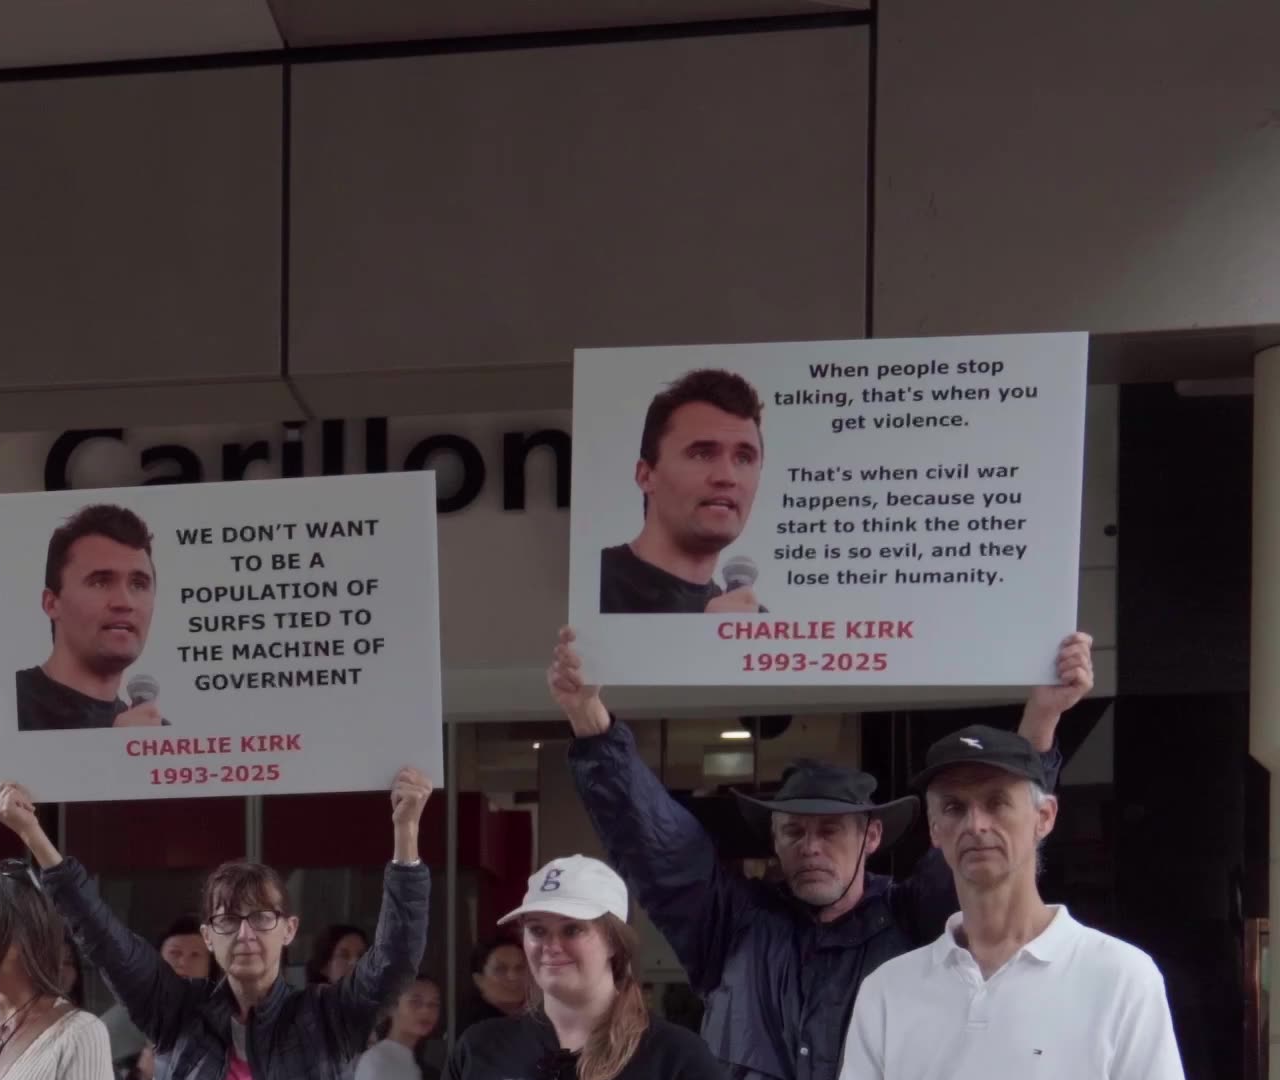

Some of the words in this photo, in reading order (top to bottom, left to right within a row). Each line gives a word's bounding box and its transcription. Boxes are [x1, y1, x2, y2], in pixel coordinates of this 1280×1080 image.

[809, 363, 868, 378] When
[878, 360, 949, 380] people
[957, 360, 1003, 376] stop
[775, 390, 853, 407] talking,
[862, 387, 923, 402] that's
[932, 386, 989, 400] when
[999, 387, 1037, 402] you
[832, 416, 865, 433] get
[873, 413, 968, 428] violence.
[788, 467, 852, 482] That's
[860, 466, 917, 480] when
[926, 464, 968, 479] civil
[978, 467, 1019, 478] war
[783, 494, 878, 511] happens,
[887, 492, 974, 506] because
[983, 493, 1021, 508] you
[176, 528, 212, 545] WE
[223, 524, 297, 543] DON'T
[306, 520, 378, 538] WANT
[777, 520, 826, 533] start
[834, 520, 854, 533] to
[862, 517, 916, 532] think
[925, 517, 959, 531] the
[968, 516, 1026, 530] other
[774, 544, 816, 559] side
[825, 544, 840, 559] is
[848, 547, 871, 559] so
[880, 543, 922, 560] evil,
[932, 542, 970, 557] and
[980, 542, 1027, 559] they
[231, 555, 262, 572] TO
[272, 553, 300, 570] BE
[310, 552, 324, 568] A
[788, 571, 829, 585] lose
[837, 570, 887, 584] their
[896, 569, 1003, 586] humanity.
[181, 581, 337, 603] POPULATION
[347, 579, 378, 596] OF
[189, 614, 265, 632] SURFS
[274, 611, 331, 628] TIED
[340, 609, 371, 626] TO
[718, 622, 835, 639] CHARLIE
[846, 621, 913, 638] KIRK
[177, 645, 222, 662] THE
[233, 640, 344, 660] MACHINE
[354, 638, 384, 655] OF
[743, 653, 887, 671] 1993-2025
[195, 668, 362, 690] GOVERNMENT
[126, 737, 231, 756] CHARLIE
[241, 734, 300, 752] KIRK
[151, 764, 280, 784] 1993-2025
